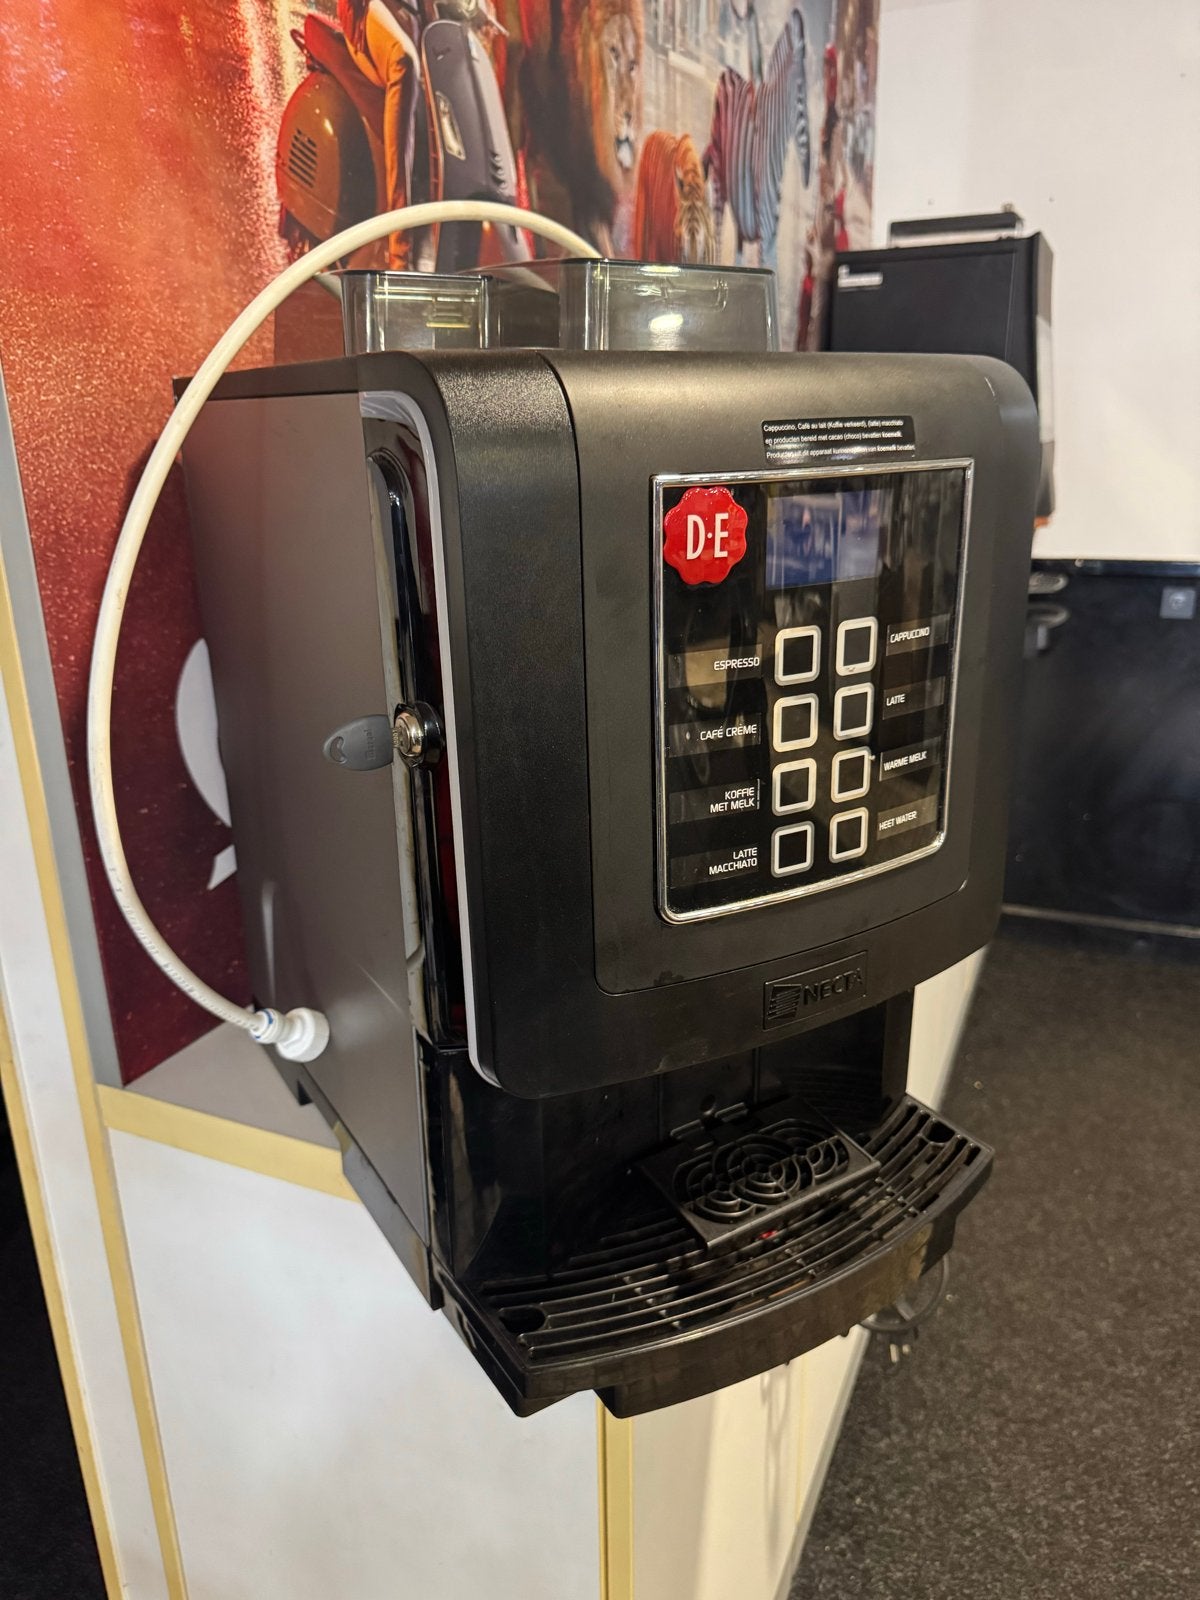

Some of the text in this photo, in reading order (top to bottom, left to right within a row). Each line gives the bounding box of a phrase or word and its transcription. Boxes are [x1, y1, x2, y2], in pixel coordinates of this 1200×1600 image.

[763, 424, 797, 433] Cappuccino,
[773, 436, 800, 445] producten
[801, 434, 817, 442] bereid
[890, 626, 930, 643] CAPPUCCINO
[714, 657, 760, 671] ESPRESSO
[886, 694, 905, 706] LATTE
[700, 726, 723, 741] CAFÉ
[883, 750, 928, 772] WARME MELK
[724, 787, 755, 800] KOFFIE
[710, 798, 755, 814] MET MELK
[879, 810, 917, 831] HEET WATER
[733, 847, 758, 860] LATTE
[708, 858, 758, 875] MACCHIATO
[802, 967, 862, 1006] NECTA
